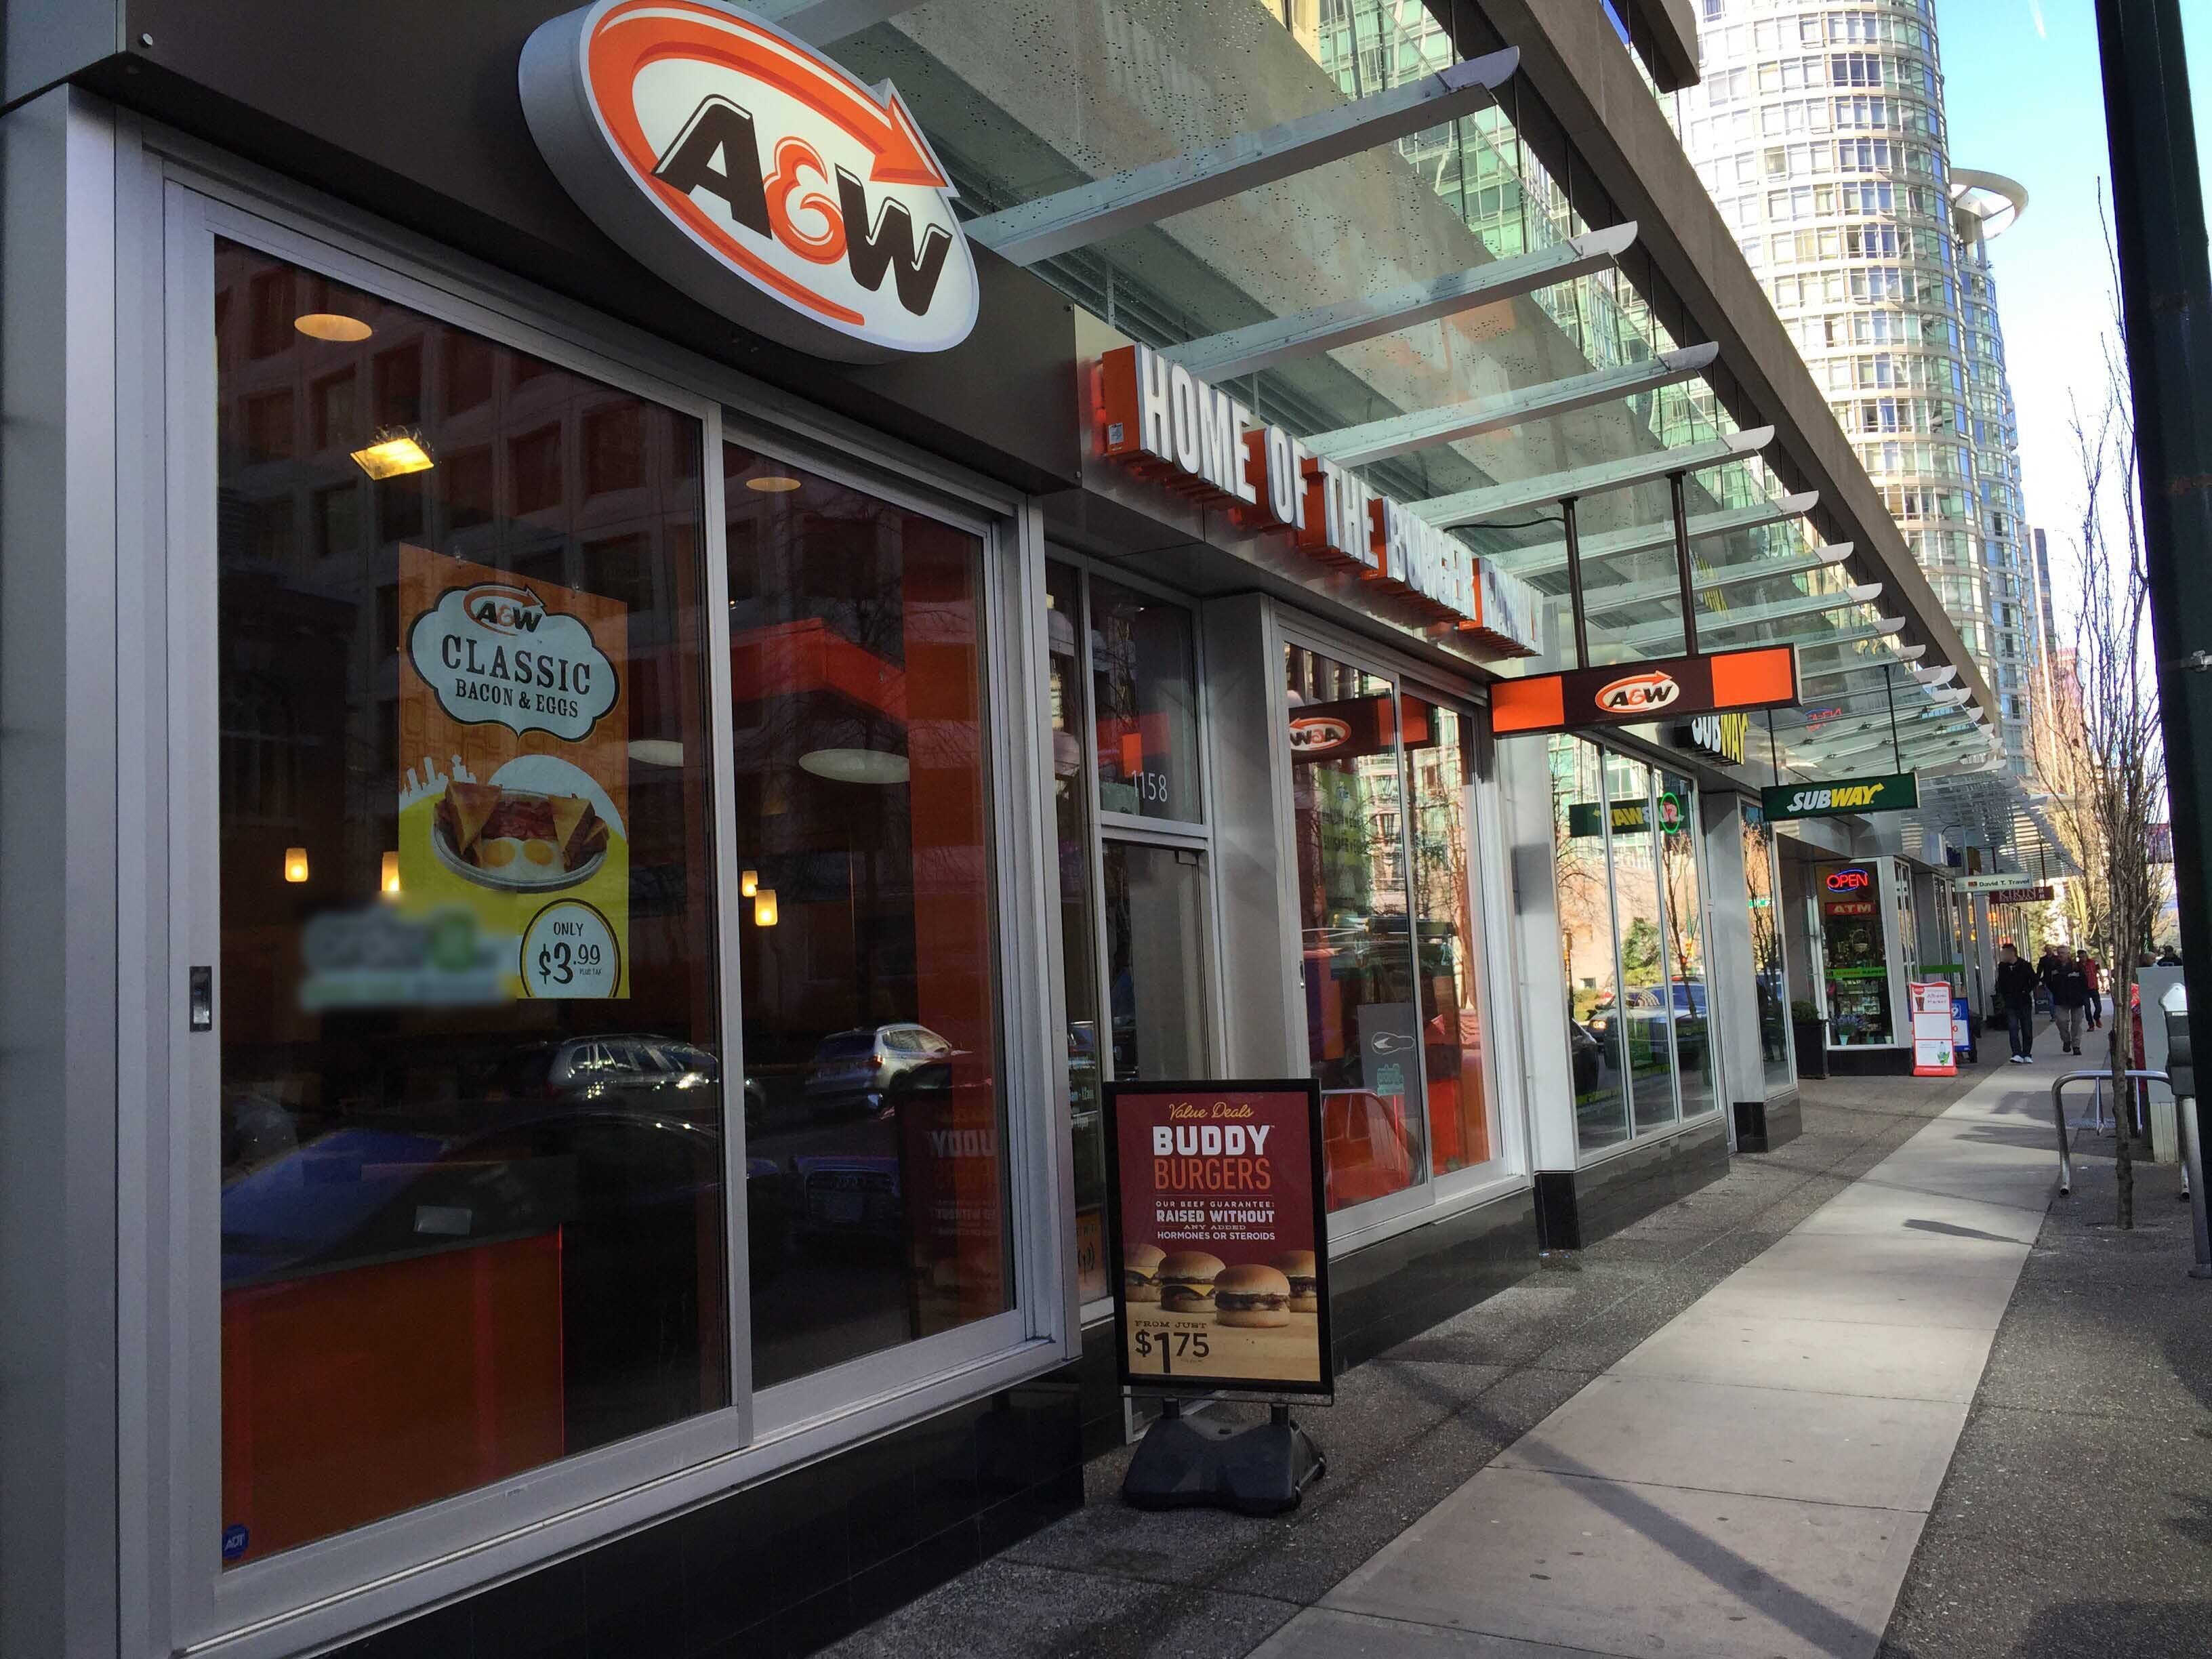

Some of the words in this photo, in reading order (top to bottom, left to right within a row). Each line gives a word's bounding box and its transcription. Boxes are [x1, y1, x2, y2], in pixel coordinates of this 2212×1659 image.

[651, 94, 952, 316] A&W
[1134, 341, 1257, 506] HOME
[1265, 425, 1309, 531] OF
[1318, 455, 1380, 570] THE
[474, 600, 542, 633] A&W
[442, 634, 591, 695] CLASSIC
[455, 678, 513, 707] BACON
[519, 691, 531, 710] &
[535, 694, 579, 718] EGGS
[1607, 684, 1674, 708] A&W
[1692, 713, 1749, 765] SUBWAY
[1131, 769, 1168, 802] 1158
[1786, 782, 1885, 813] SUBWAY
[1826, 872, 1869, 888] OPEN
[1999, 888, 2036, 899] KIRIN
[1833, 903, 1872, 914] ATM
[553, 922, 584, 937] ONLY
[539, 942, 600, 985] $3.99
[1169, 1102, 1208, 1120] Value
[1212, 1101, 1254, 1118] Deals
[1153, 1125, 1270, 1155] BUDDY
[1153, 1158, 1271, 1190] BURGERS
[1156, 1210, 1204, 1223] RAISED
[1210, 1210, 1275, 1223] WITHOUT
[1158, 1231, 1210, 1240] HORMONES
[1229, 1232, 1275, 1240] STEROIDS
[1135, 1320, 1170, 1328] FROM
[224, 1532, 245, 1551] ADT
